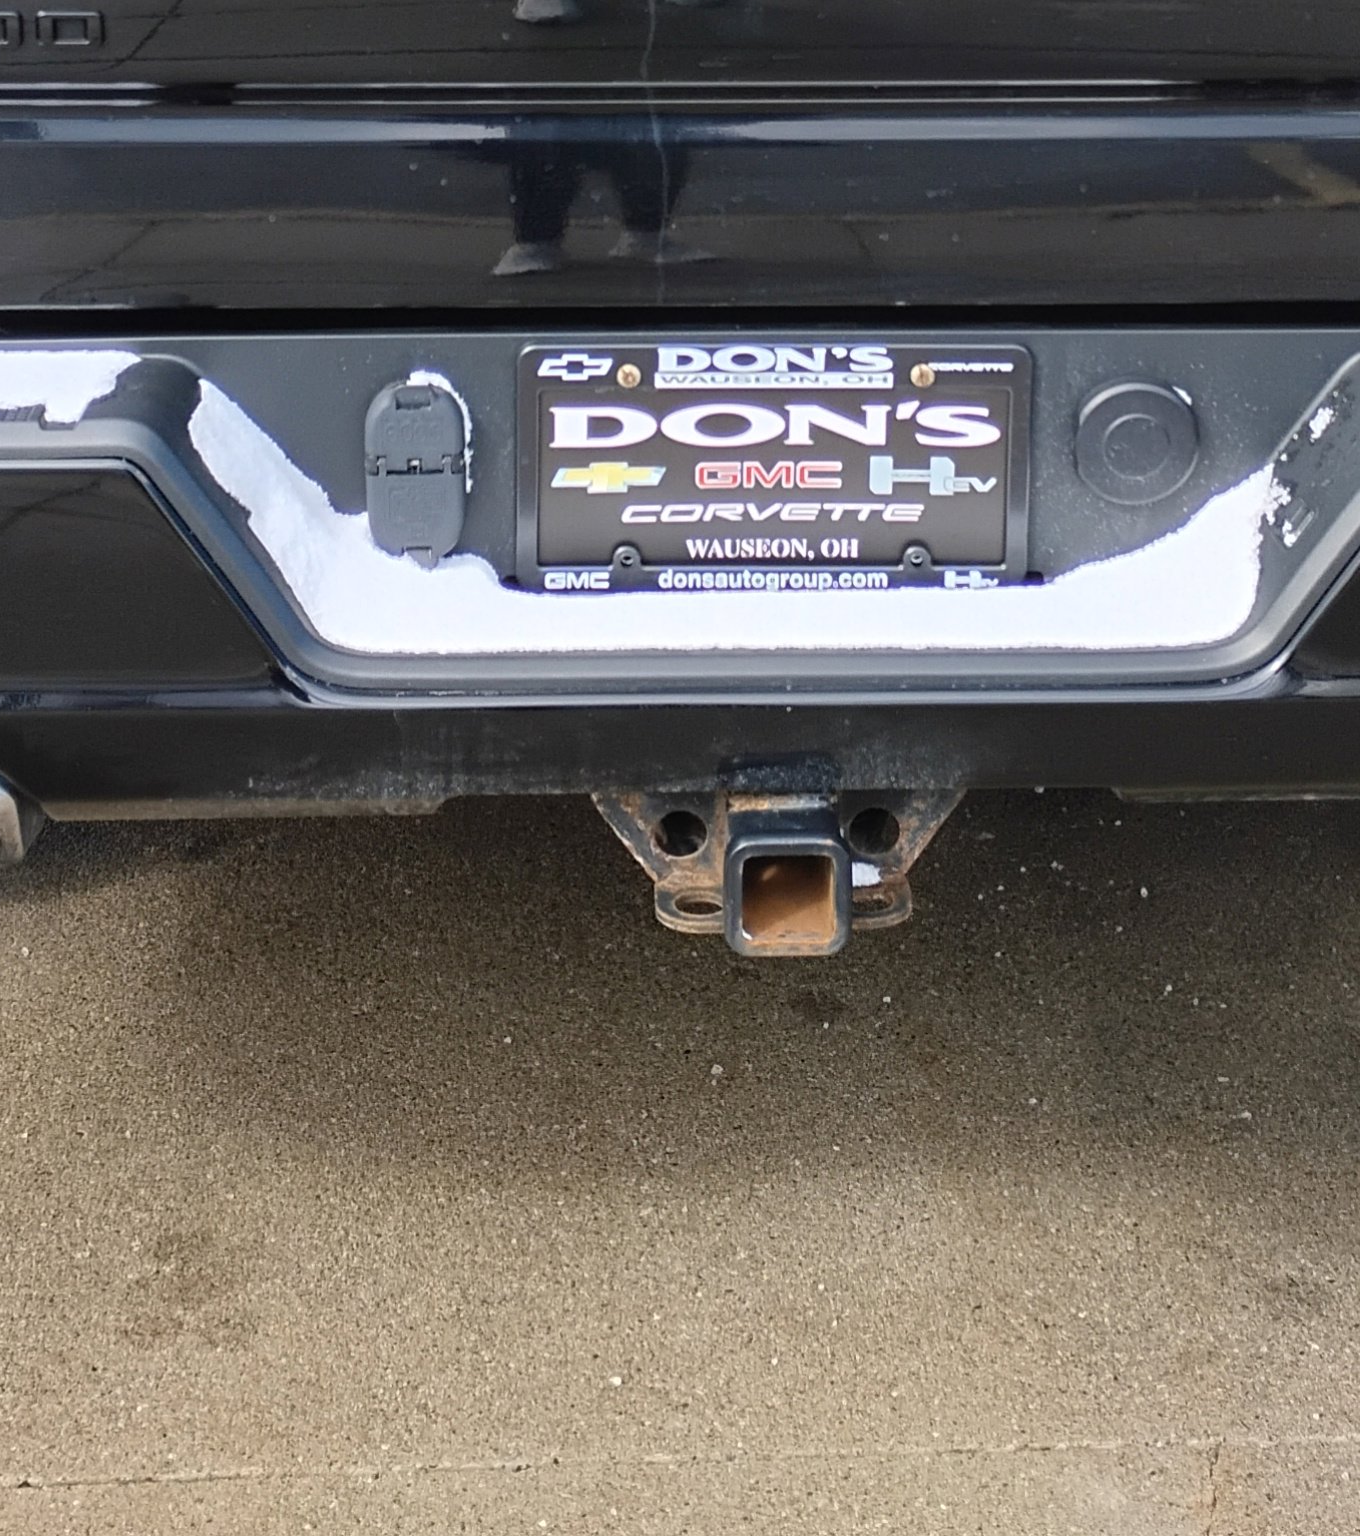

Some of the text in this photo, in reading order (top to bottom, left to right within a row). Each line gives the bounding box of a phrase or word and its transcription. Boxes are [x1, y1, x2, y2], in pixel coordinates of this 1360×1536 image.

[658, 346, 894, 373] DON'S
[661, 375, 889, 385] WAUSEON, OH
[549, 400, 1001, 448] DON'S
[695, 461, 842, 489] GMC
[621, 503, 925, 523] CORVETTE
[685, 538, 859, 561] WAUSEON, OH
[544, 572, 610, 590] GMC
[658, 569, 889, 592] donsautogroup.com
